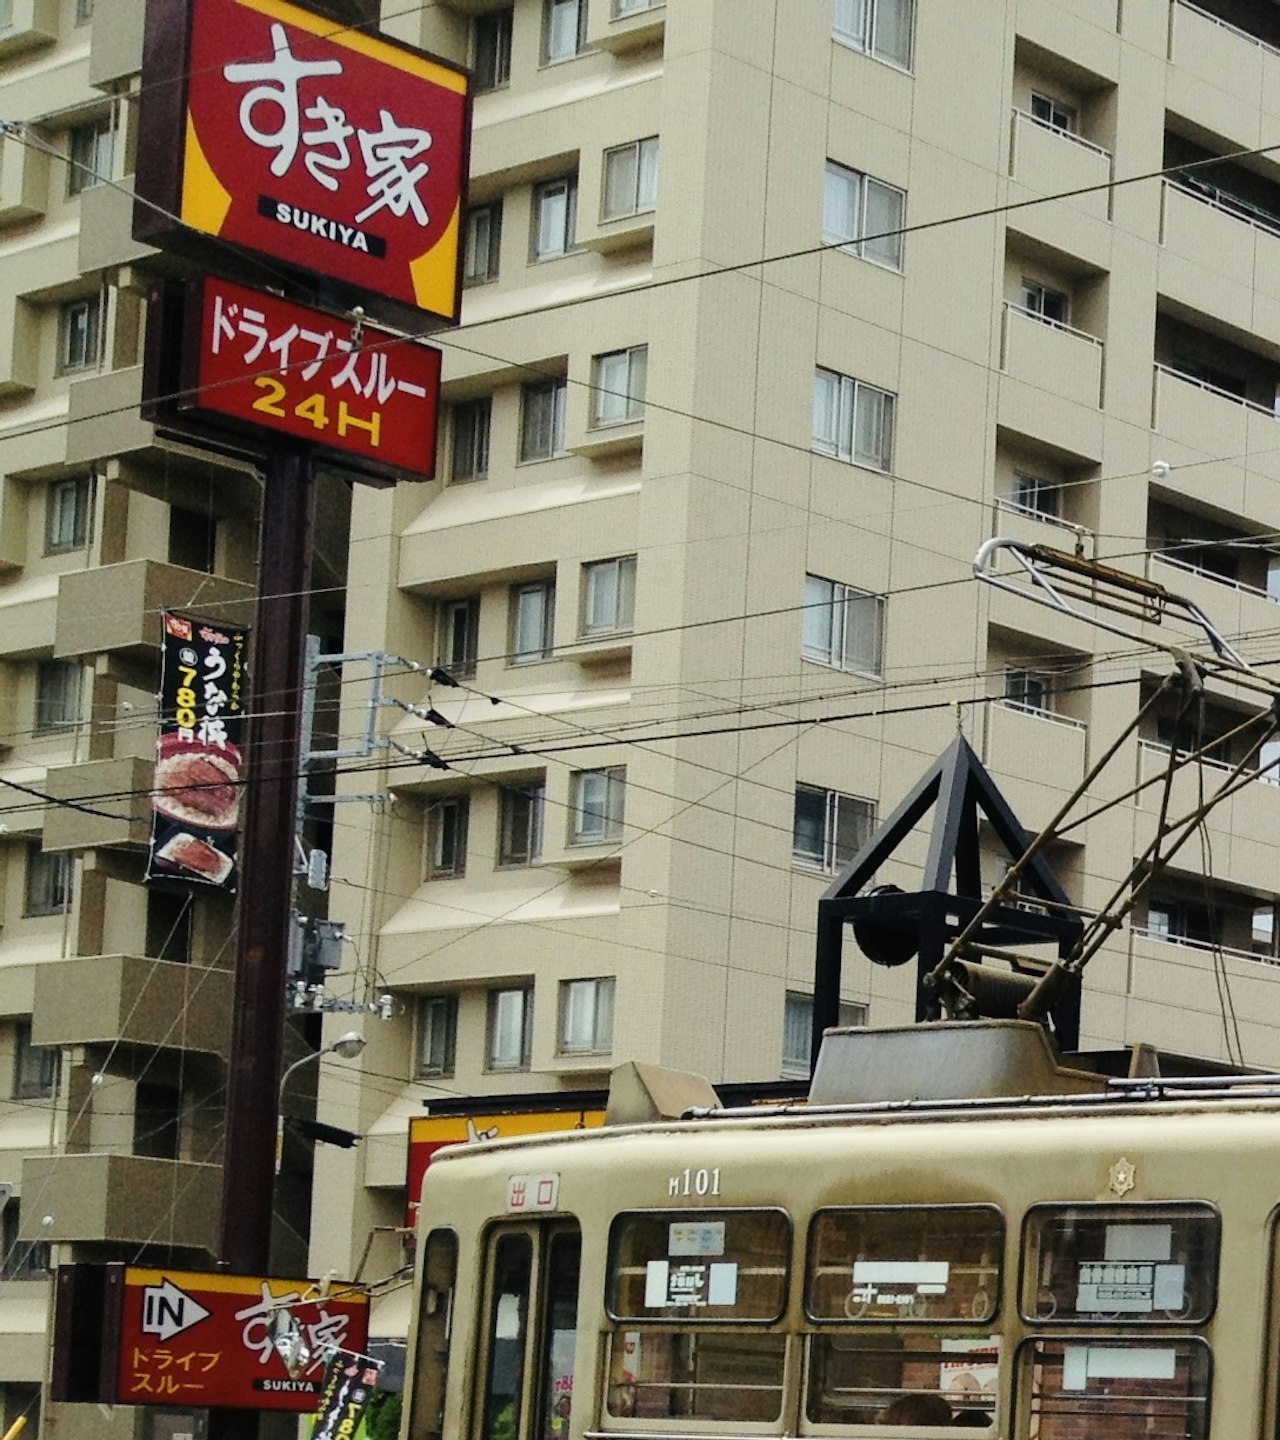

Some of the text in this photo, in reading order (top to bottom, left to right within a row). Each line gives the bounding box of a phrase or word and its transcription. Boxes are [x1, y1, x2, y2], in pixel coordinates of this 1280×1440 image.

[222, 22, 432, 228] すき家
[275, 203, 370, 253] SUKIYA
[211, 295, 428, 405] ドライブスルー
[252, 377, 382, 448] 24H
[176, 665, 197, 743] 780円
[510, 1179, 554, 1206] 出口
[668, 1168, 721, 1196] M101
[146, 1295, 184, 1327] IN
[234, 1280, 349, 1376] す家
[132, 1348, 222, 1372] ドライブ
[131, 1375, 204, 1393] スルー
[262, 1378, 315, 1392] SUKIYA
